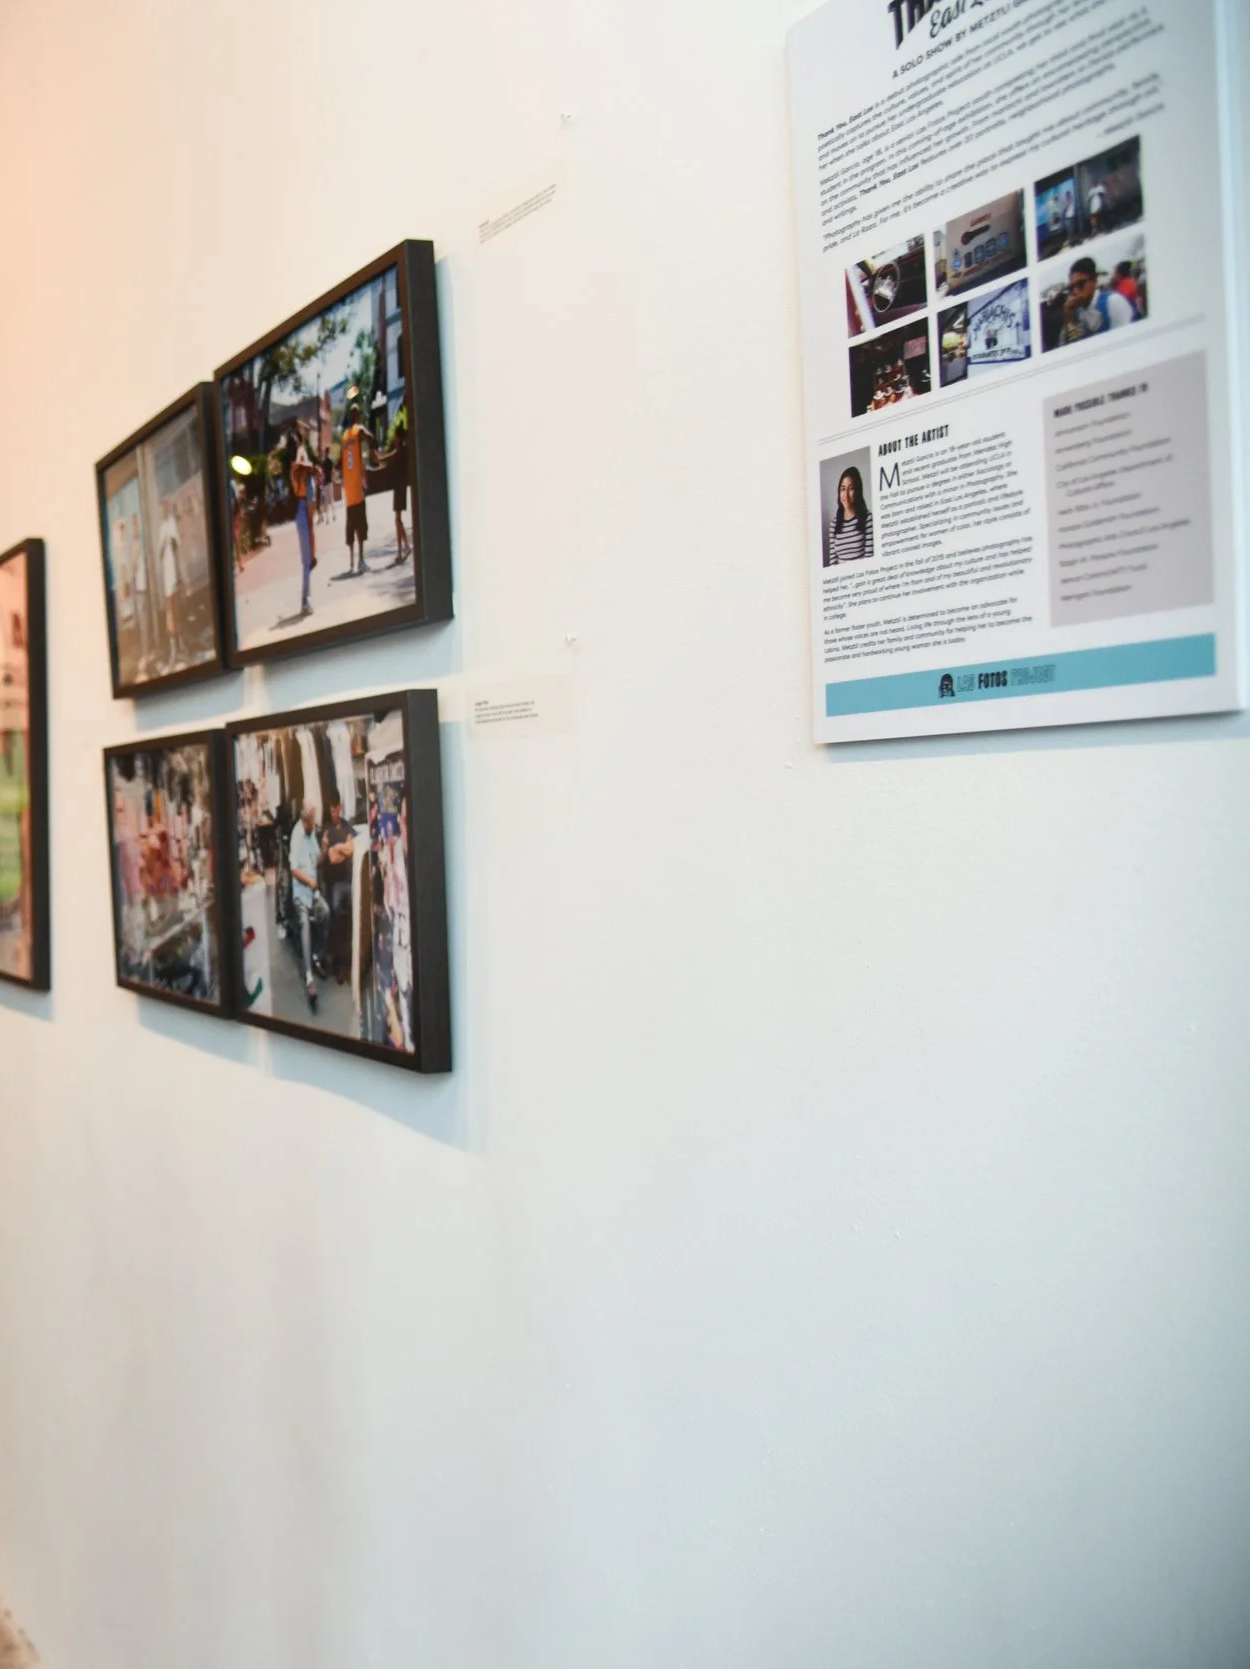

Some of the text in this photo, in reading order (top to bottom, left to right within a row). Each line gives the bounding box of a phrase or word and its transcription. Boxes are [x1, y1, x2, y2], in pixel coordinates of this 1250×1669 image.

[892, 69, 899, 79] A
[900, 55, 923, 74] SOLO
[926, 40, 952, 59] SHOW
[955, 29, 966, 41] BY
[878, 424, 949, 457] ABOUT THE ARTIST
[978, 670, 1007, 689] FOTOS
